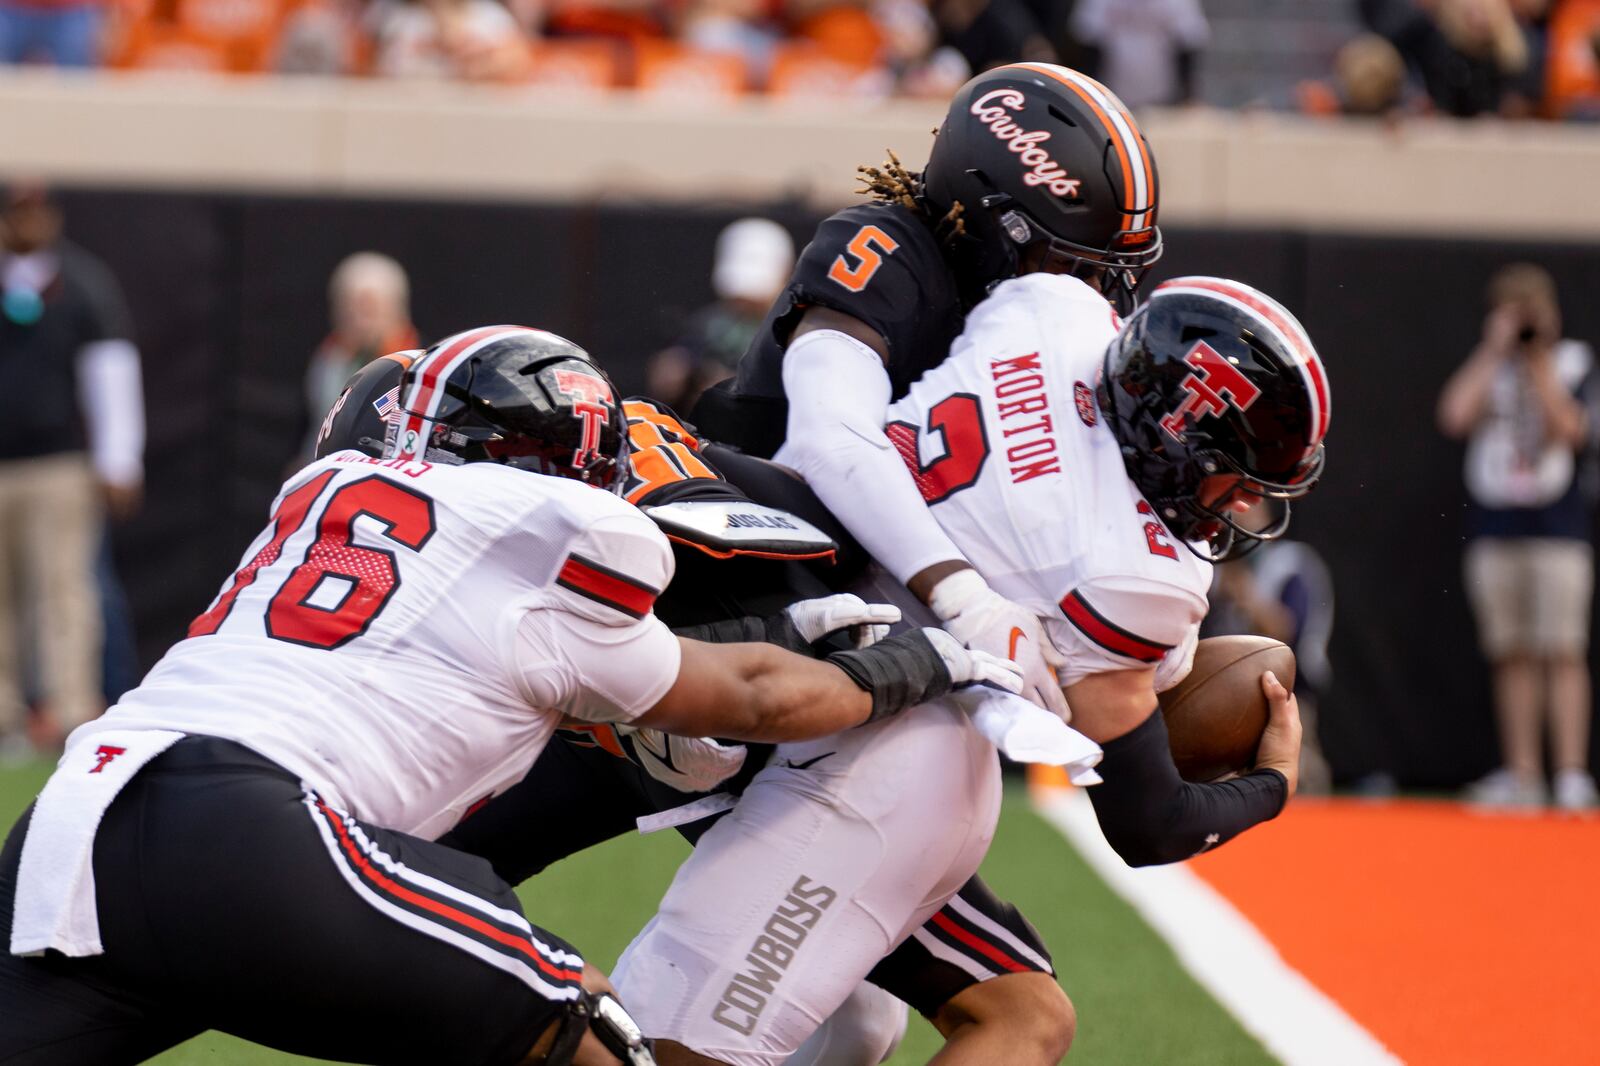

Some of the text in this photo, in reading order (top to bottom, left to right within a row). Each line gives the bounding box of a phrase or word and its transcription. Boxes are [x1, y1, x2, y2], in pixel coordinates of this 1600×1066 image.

[970, 88, 1082, 199] Cowboys
[827, 225, 900, 293] 5
[883, 391, 991, 508] 2
[990, 351, 1062, 484] MORTON
[187, 466, 438, 652] 76
[711, 874, 837, 1037] COWBOYS
